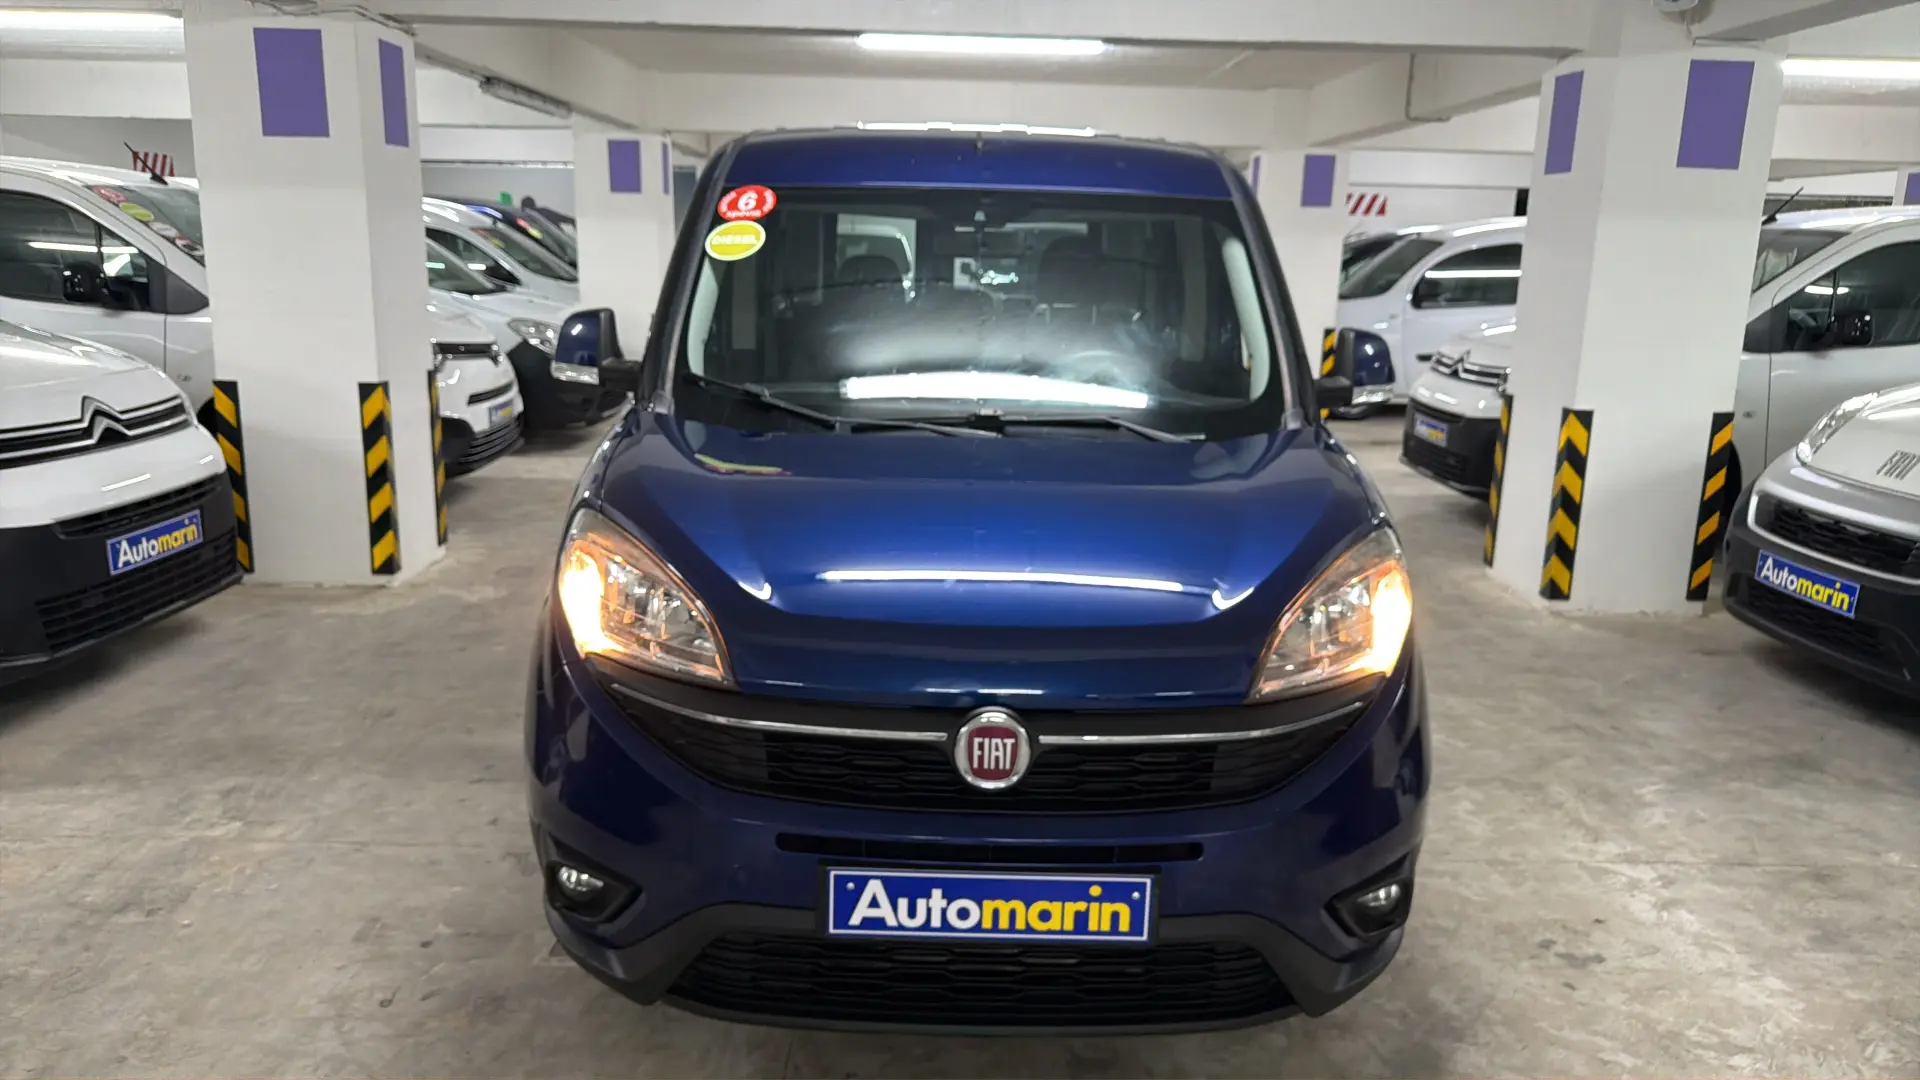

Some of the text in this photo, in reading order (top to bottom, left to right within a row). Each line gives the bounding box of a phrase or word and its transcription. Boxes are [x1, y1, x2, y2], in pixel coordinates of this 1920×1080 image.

[737, 190, 758, 211] 6
[117, 518, 198, 568] Automarin
[1760, 556, 1850, 612] Automarin
[972, 735, 1016, 770] FIAT
[848, 878, 1131, 933] Automarin
